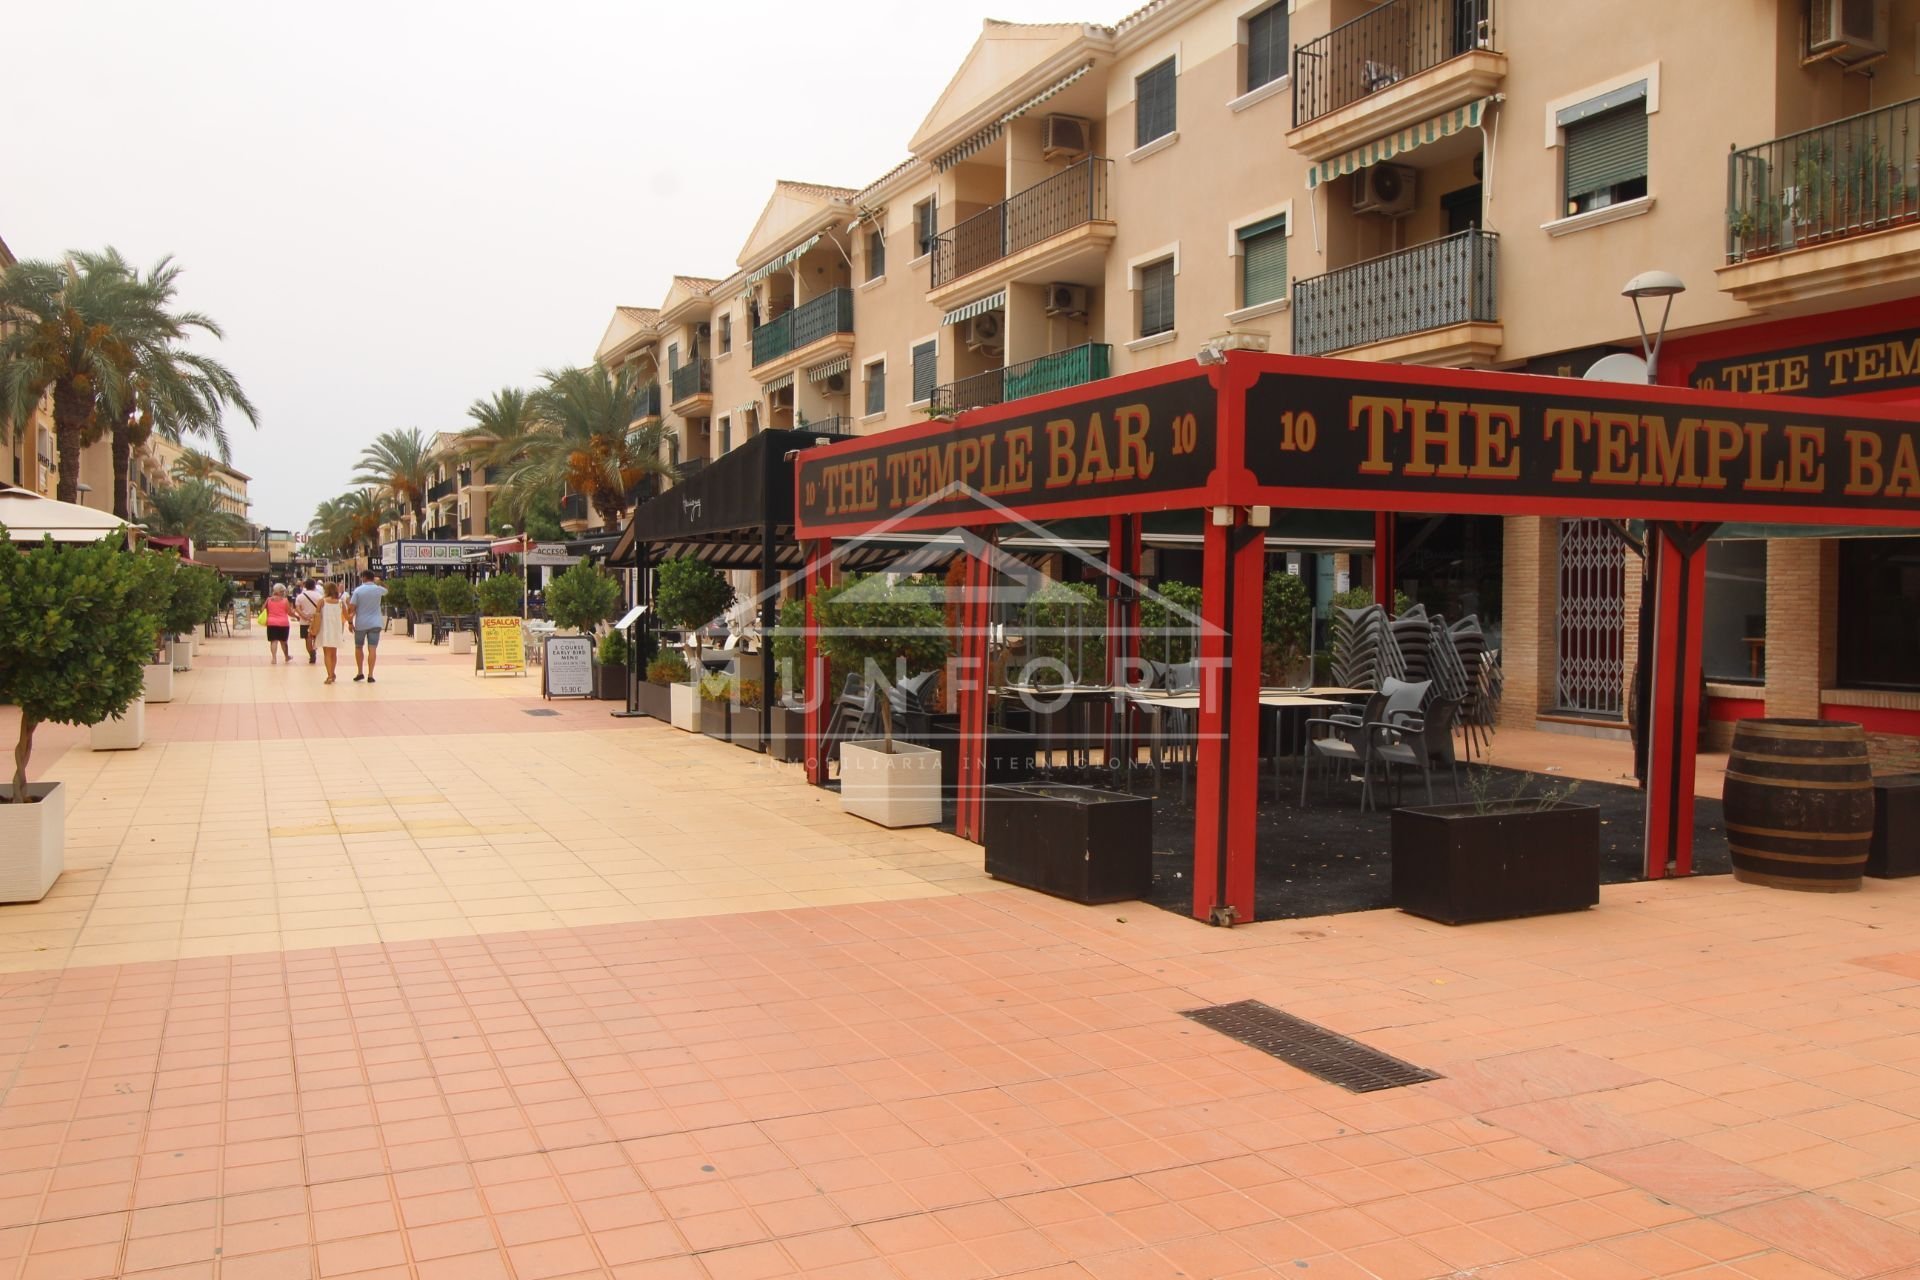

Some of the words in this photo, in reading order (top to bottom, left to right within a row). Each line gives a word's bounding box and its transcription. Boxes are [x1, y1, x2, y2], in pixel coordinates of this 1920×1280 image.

[1722, 355, 1809, 394] THE
[805, 481, 816, 506] 10
[822, 457, 879, 516] THE
[885, 426, 1033, 508] TEMPLE
[1046, 403, 1155, 489] BAR
[1172, 412, 1198, 456] 10
[1280, 411, 1317, 452] 10
[1349, 394, 1521, 480] THE
[1543, 407, 1826, 494] TEMPLE
